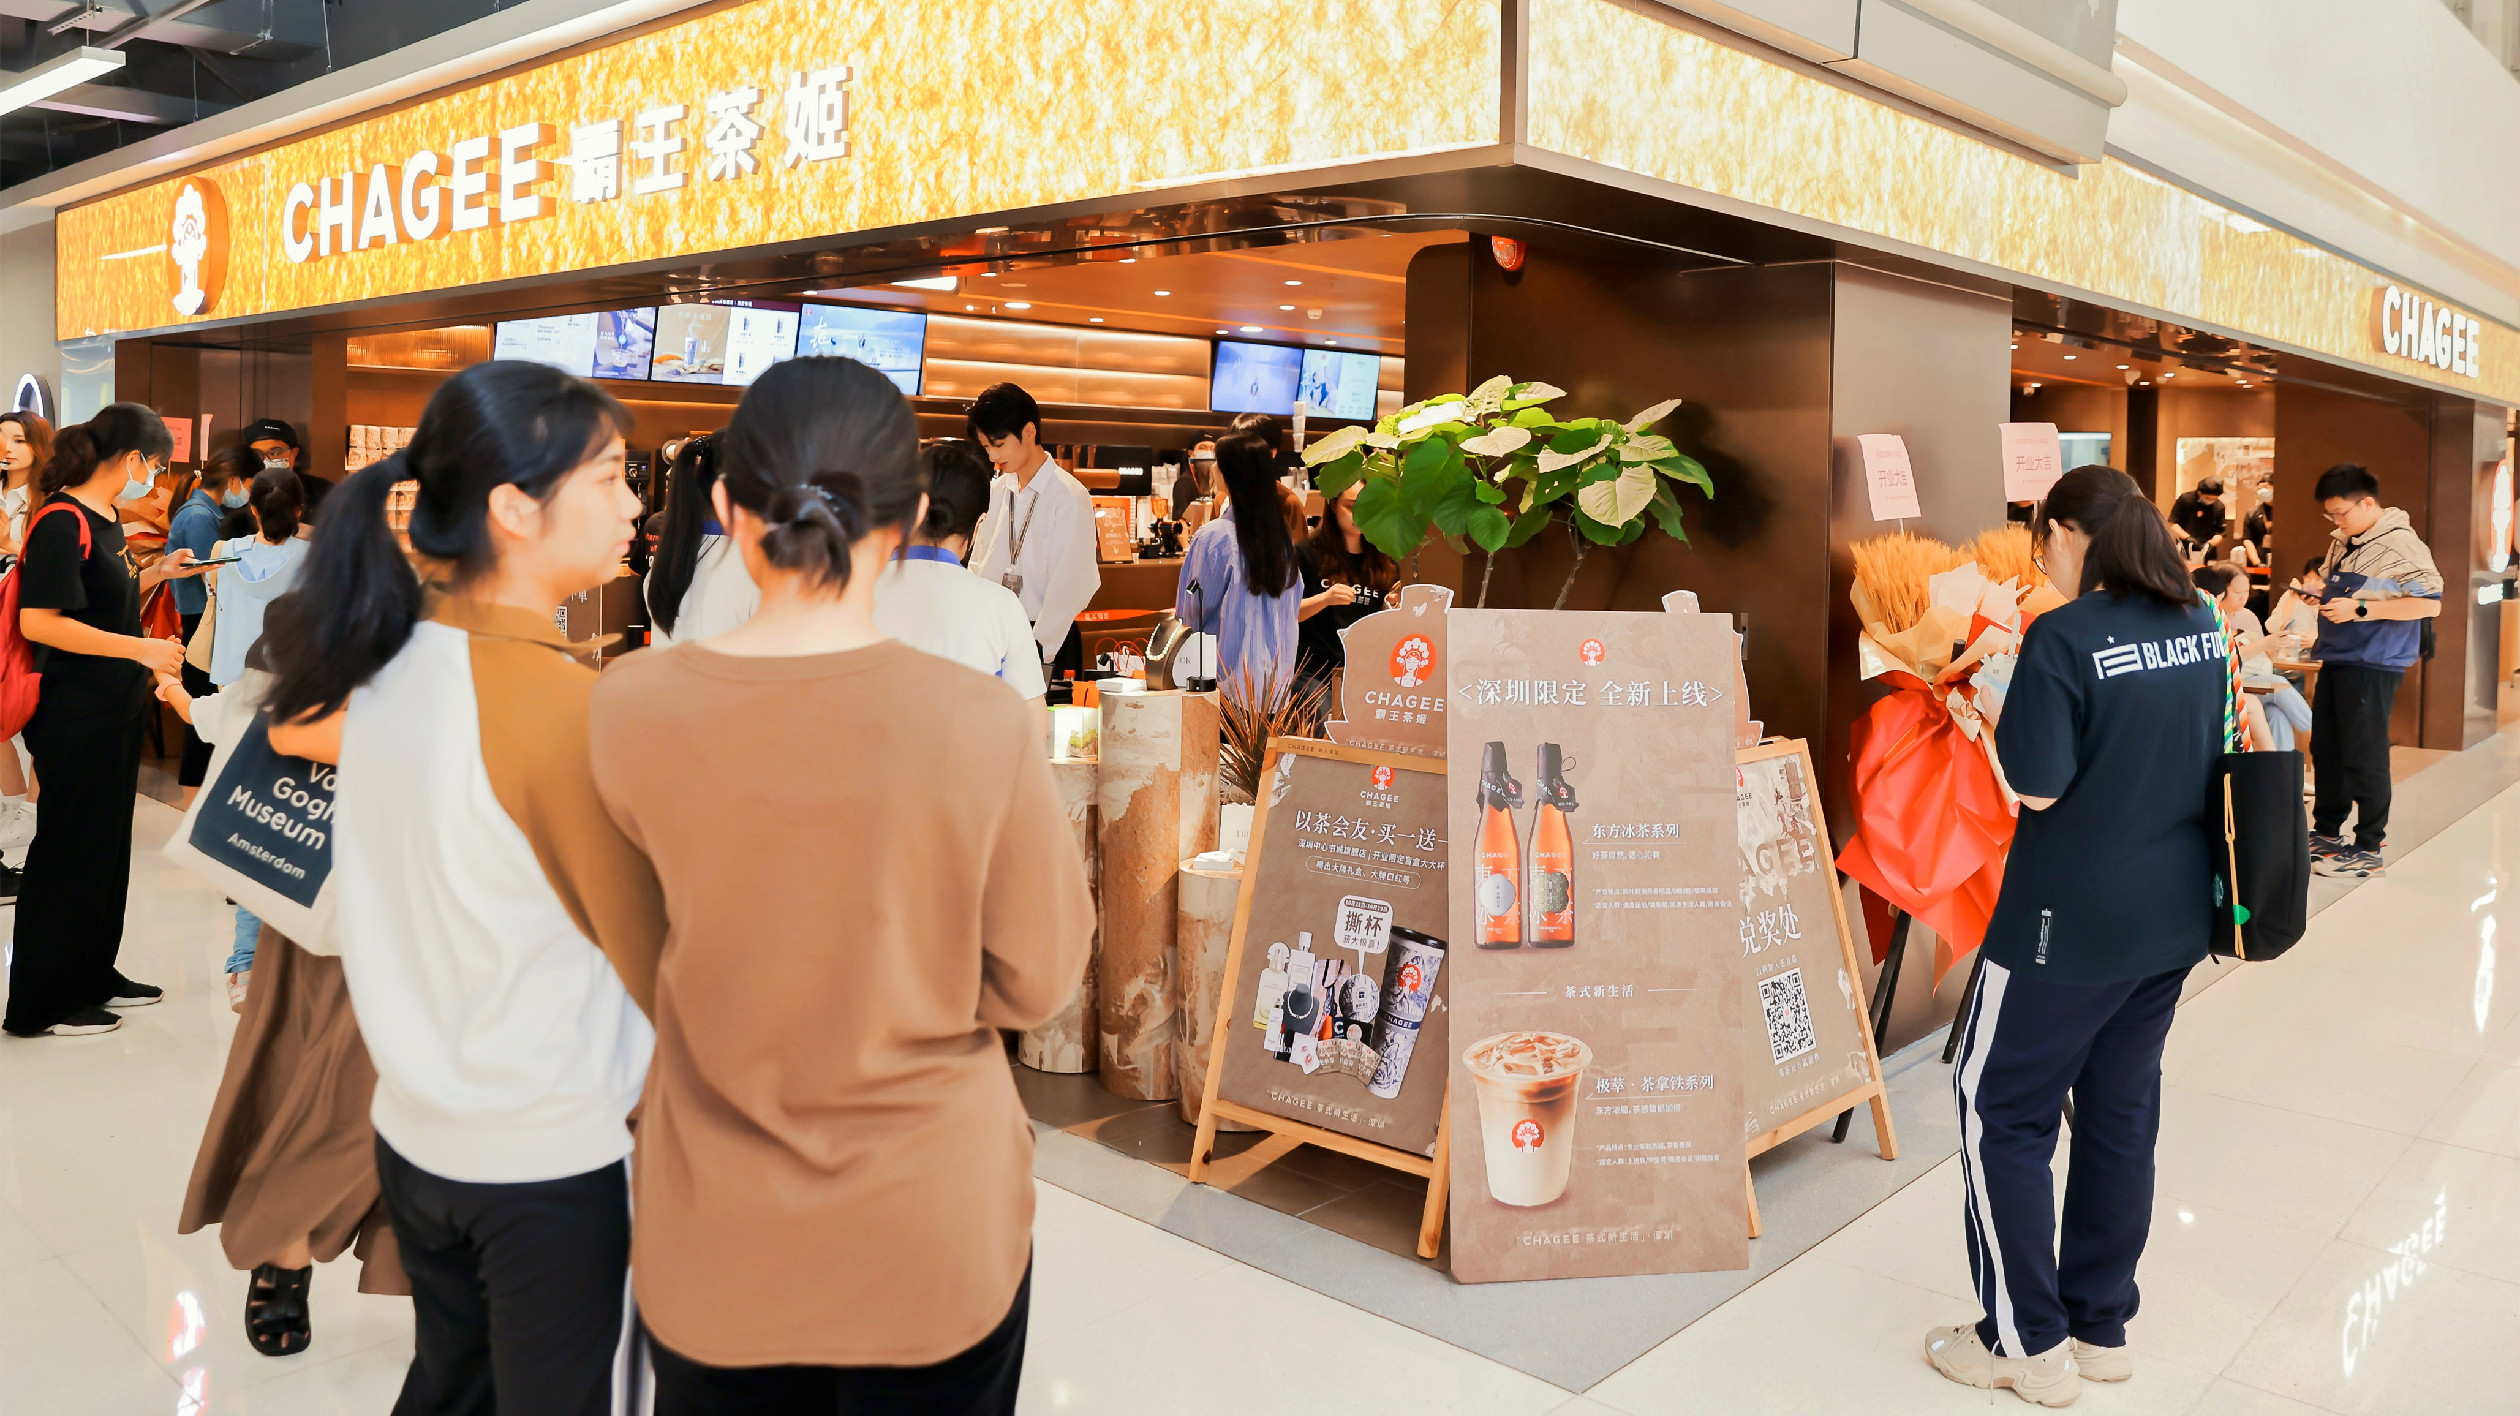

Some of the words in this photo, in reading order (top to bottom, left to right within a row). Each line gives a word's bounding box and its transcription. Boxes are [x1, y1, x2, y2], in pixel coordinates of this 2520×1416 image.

[283, 121, 552, 264] CHAGEE
[571, 66, 853, 205] 霸王茶姬
[2381, 285, 2480, 378] CHAGEE
[2016, 455, 2052, 472] 开业大吉
[1877, 470, 1908, 488] 开业大吉
[1321, 579, 1379, 598] CGEE
[2141, 635, 2201, 670] BLACK
[1365, 690, 1445, 712] CHAGEE
[1375, 708, 1428, 725] 霸王茶姬
[1360, 790, 1399, 803] CHAGEE
[227, 785, 326, 850] Museum
[1592, 823, 1680, 839] 东方冰茶系列
[227, 832, 306, 879] Amsterdam
[1345, 910, 1384, 938] 撕杯
[1564, 984, 1634, 998] 茶式新生活
